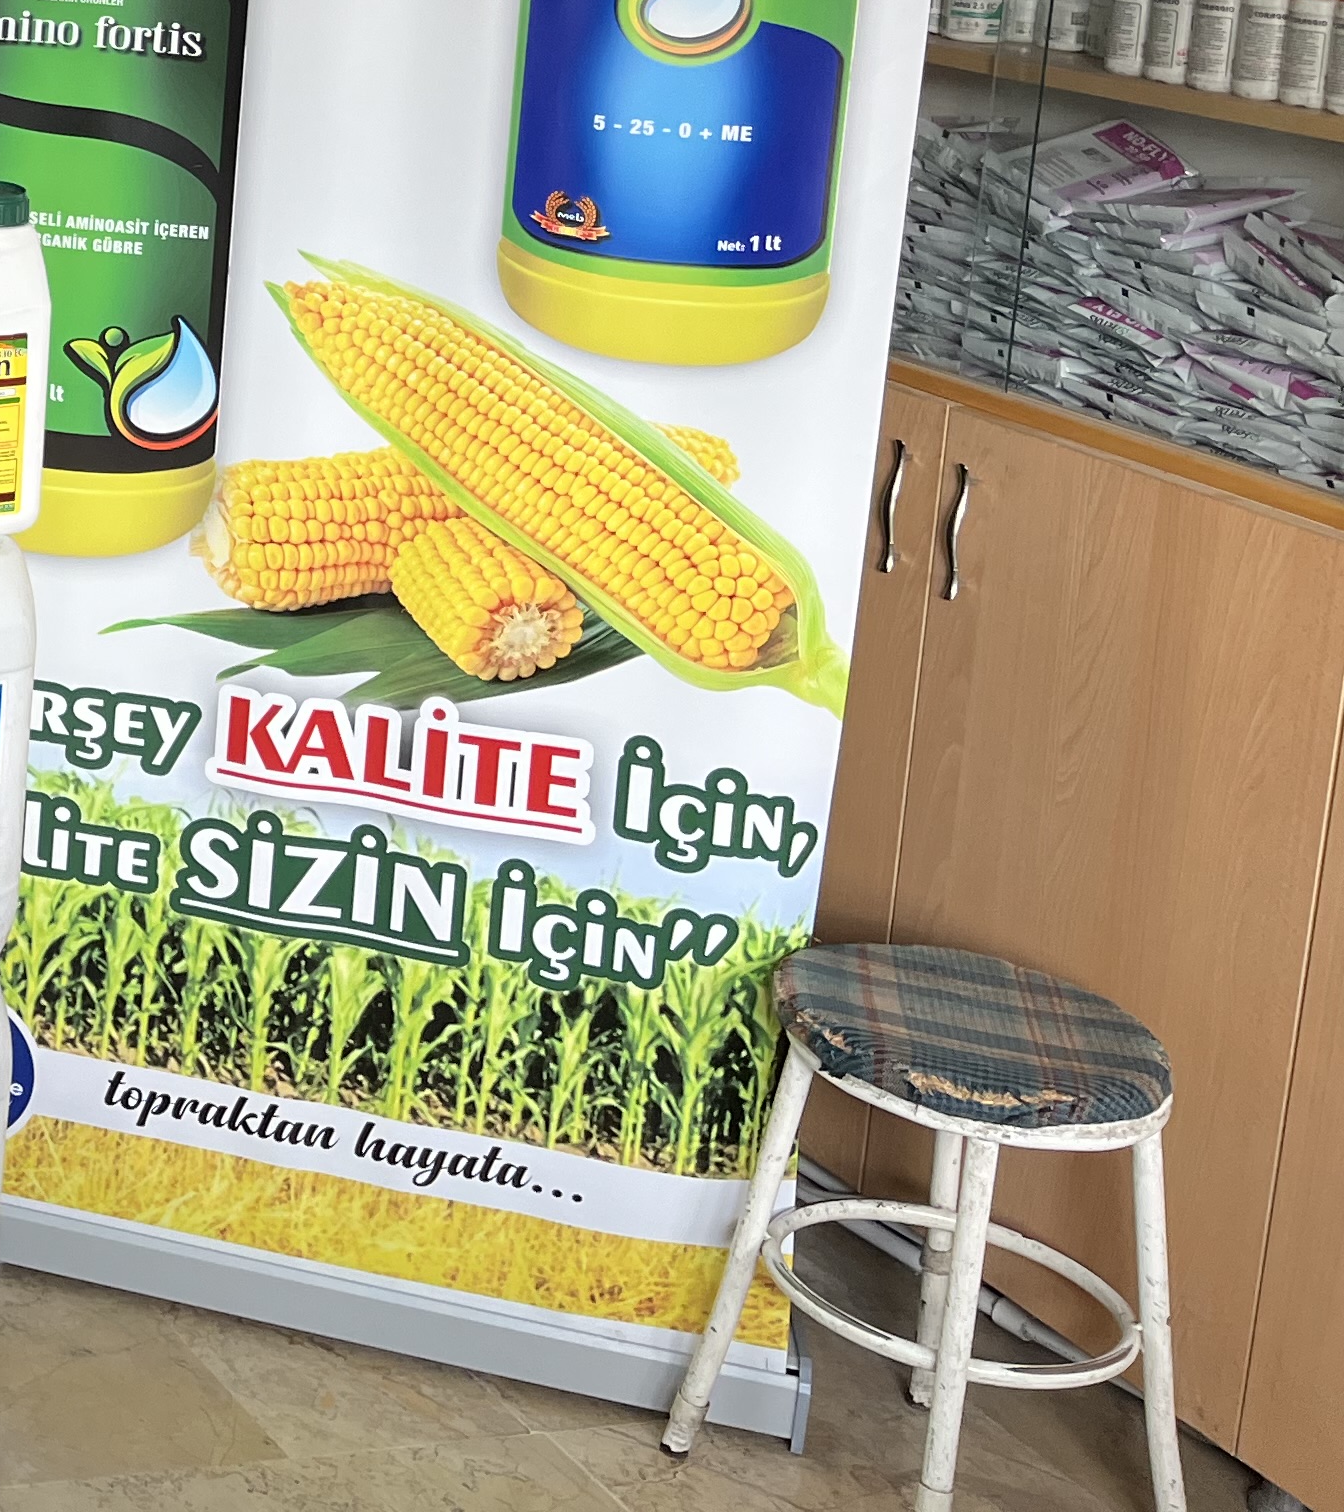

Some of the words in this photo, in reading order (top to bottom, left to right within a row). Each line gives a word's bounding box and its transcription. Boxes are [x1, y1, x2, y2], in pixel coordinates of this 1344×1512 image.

[94, 16, 202, 57] fortis
[593, 114, 606, 132] 5
[629, 118, 654, 136] 25
[679, 122, 691, 139] 0
[721, 125, 752, 142] ME
[29, 210, 62, 229] SELİ
[66, 214, 149, 236] AMİNOASİT
[154, 217, 209, 241] İÇEREN
[39, 233, 90, 252] GANİK
[93, 236, 143, 256] GÜBRE
[717, 238, 745, 253] Net:
[749, 235, 759, 251] 1
[34, 687, 192, 766] RŞEY
[226, 696, 578, 818] KALİTE
[26, 799, 153, 886] LİTE
[185, 819, 456, 941] SİZİN
[103, 1071, 339, 1152] topraktan
